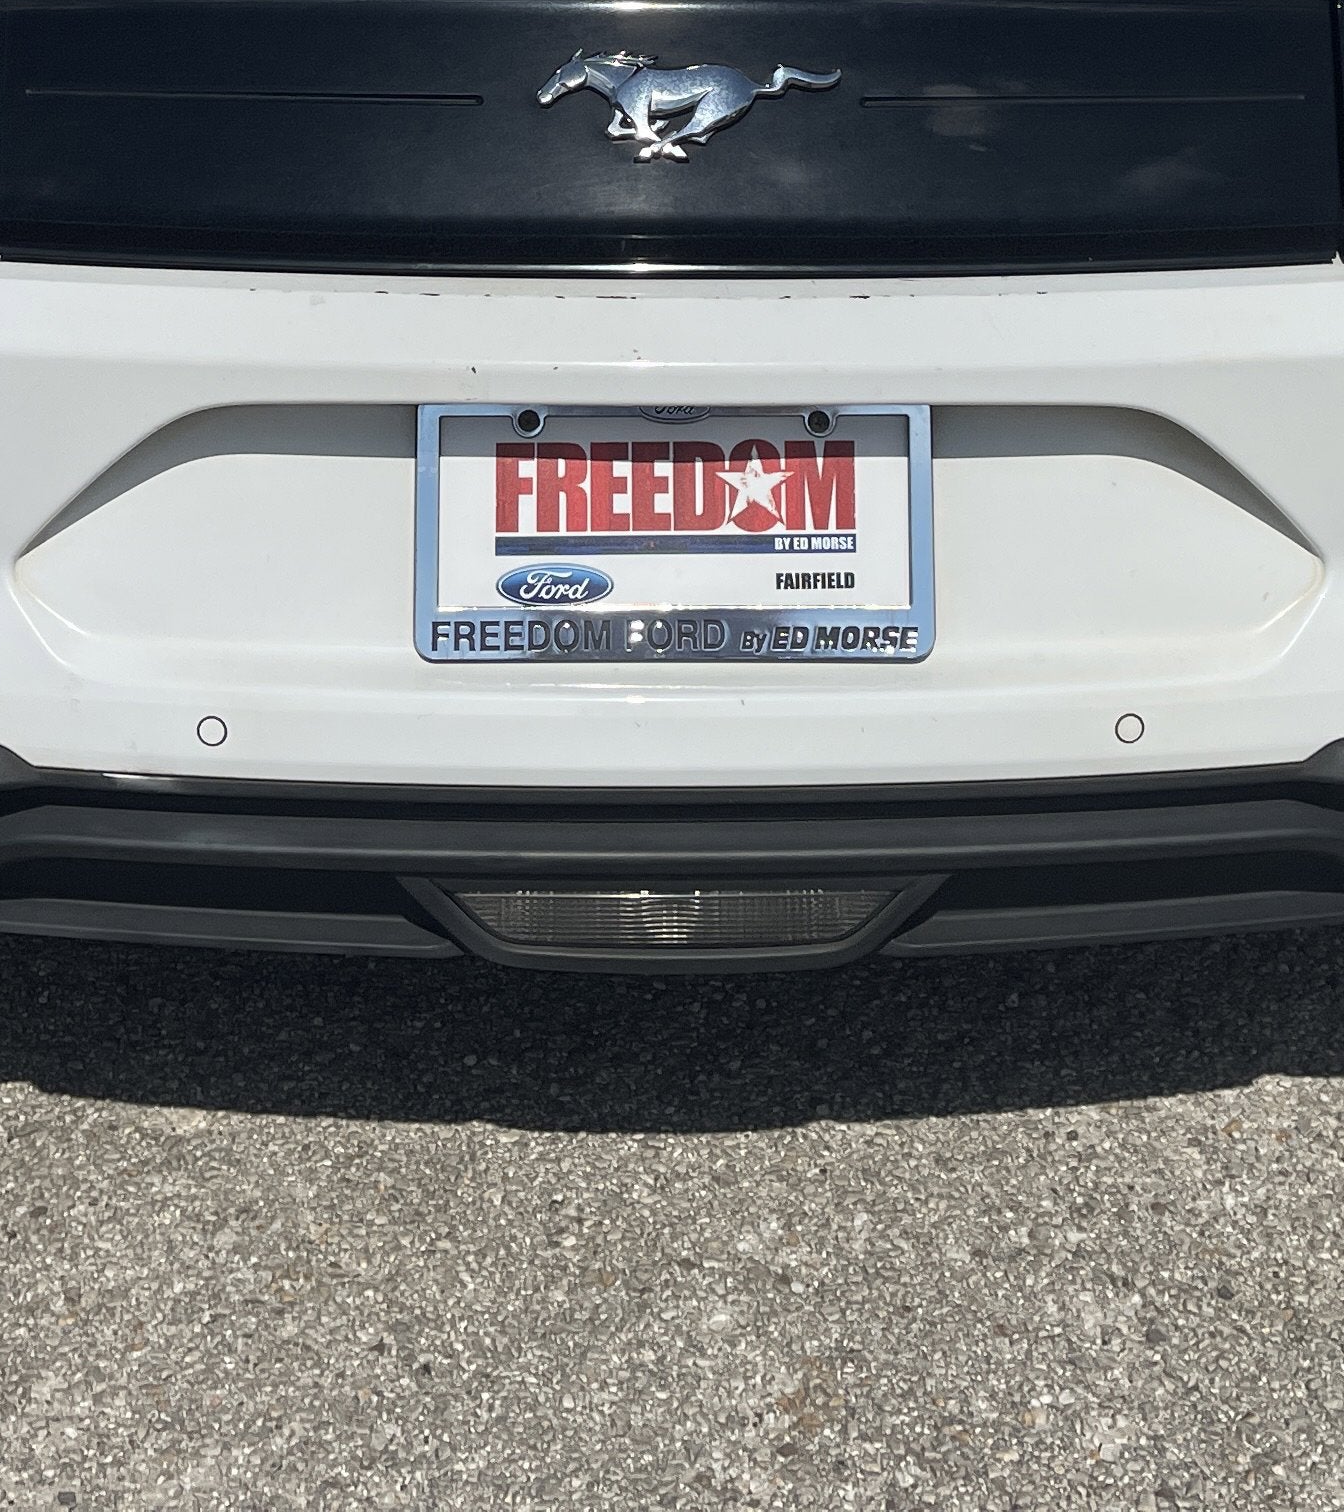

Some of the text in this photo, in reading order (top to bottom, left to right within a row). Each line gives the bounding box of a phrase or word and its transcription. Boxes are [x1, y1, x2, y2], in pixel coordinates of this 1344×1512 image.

[495, 439, 857, 533] FREEDOM
[774, 536, 854, 550] BY ED MORSE
[519, 570, 590, 600] Ford
[775, 572, 855, 590] FAIRFIELD
[430, 620, 612, 653] FREEDOM
[625, 620, 726, 653] FORD
[771, 627, 805, 651] ED
[813, 626, 920, 652] MORSE
